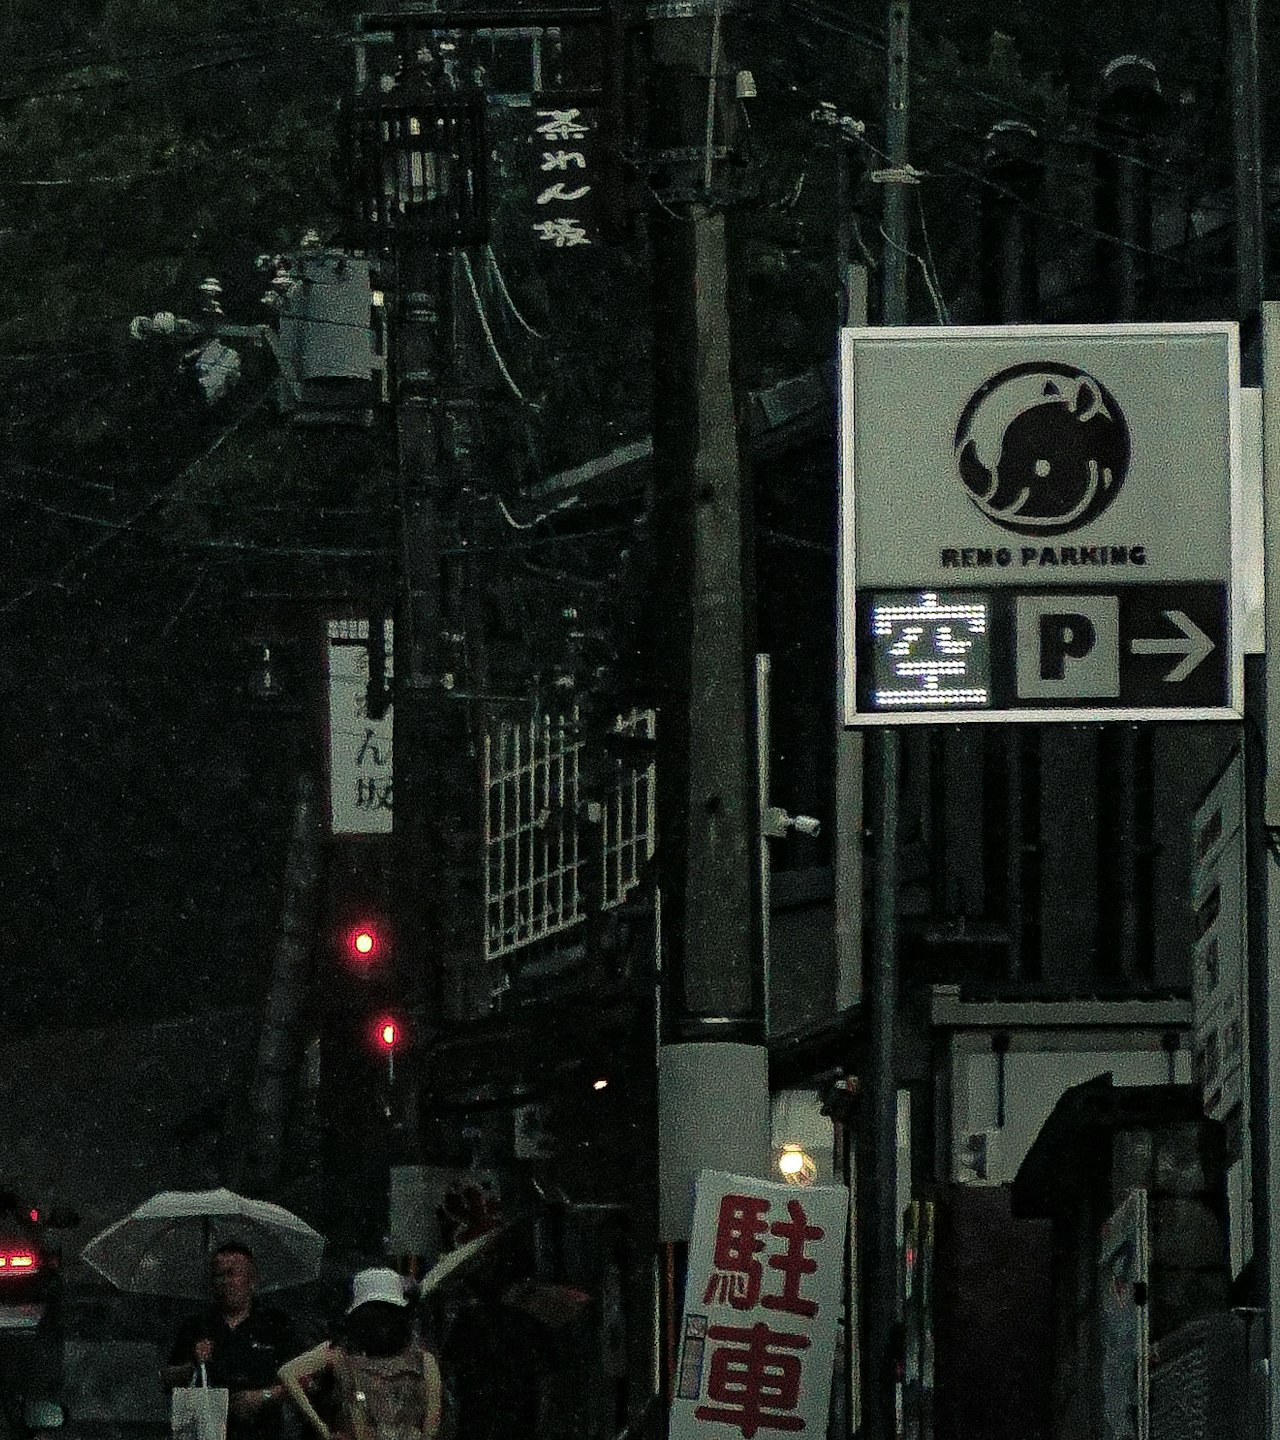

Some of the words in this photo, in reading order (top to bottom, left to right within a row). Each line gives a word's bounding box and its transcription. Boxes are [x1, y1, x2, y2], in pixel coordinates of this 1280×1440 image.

[532, 107, 592, 248] 茶わん坂
[1018, 544, 1148, 568] PARKING
[872, 591, 988, 706] 空
[1040, 612, 1096, 681] P
